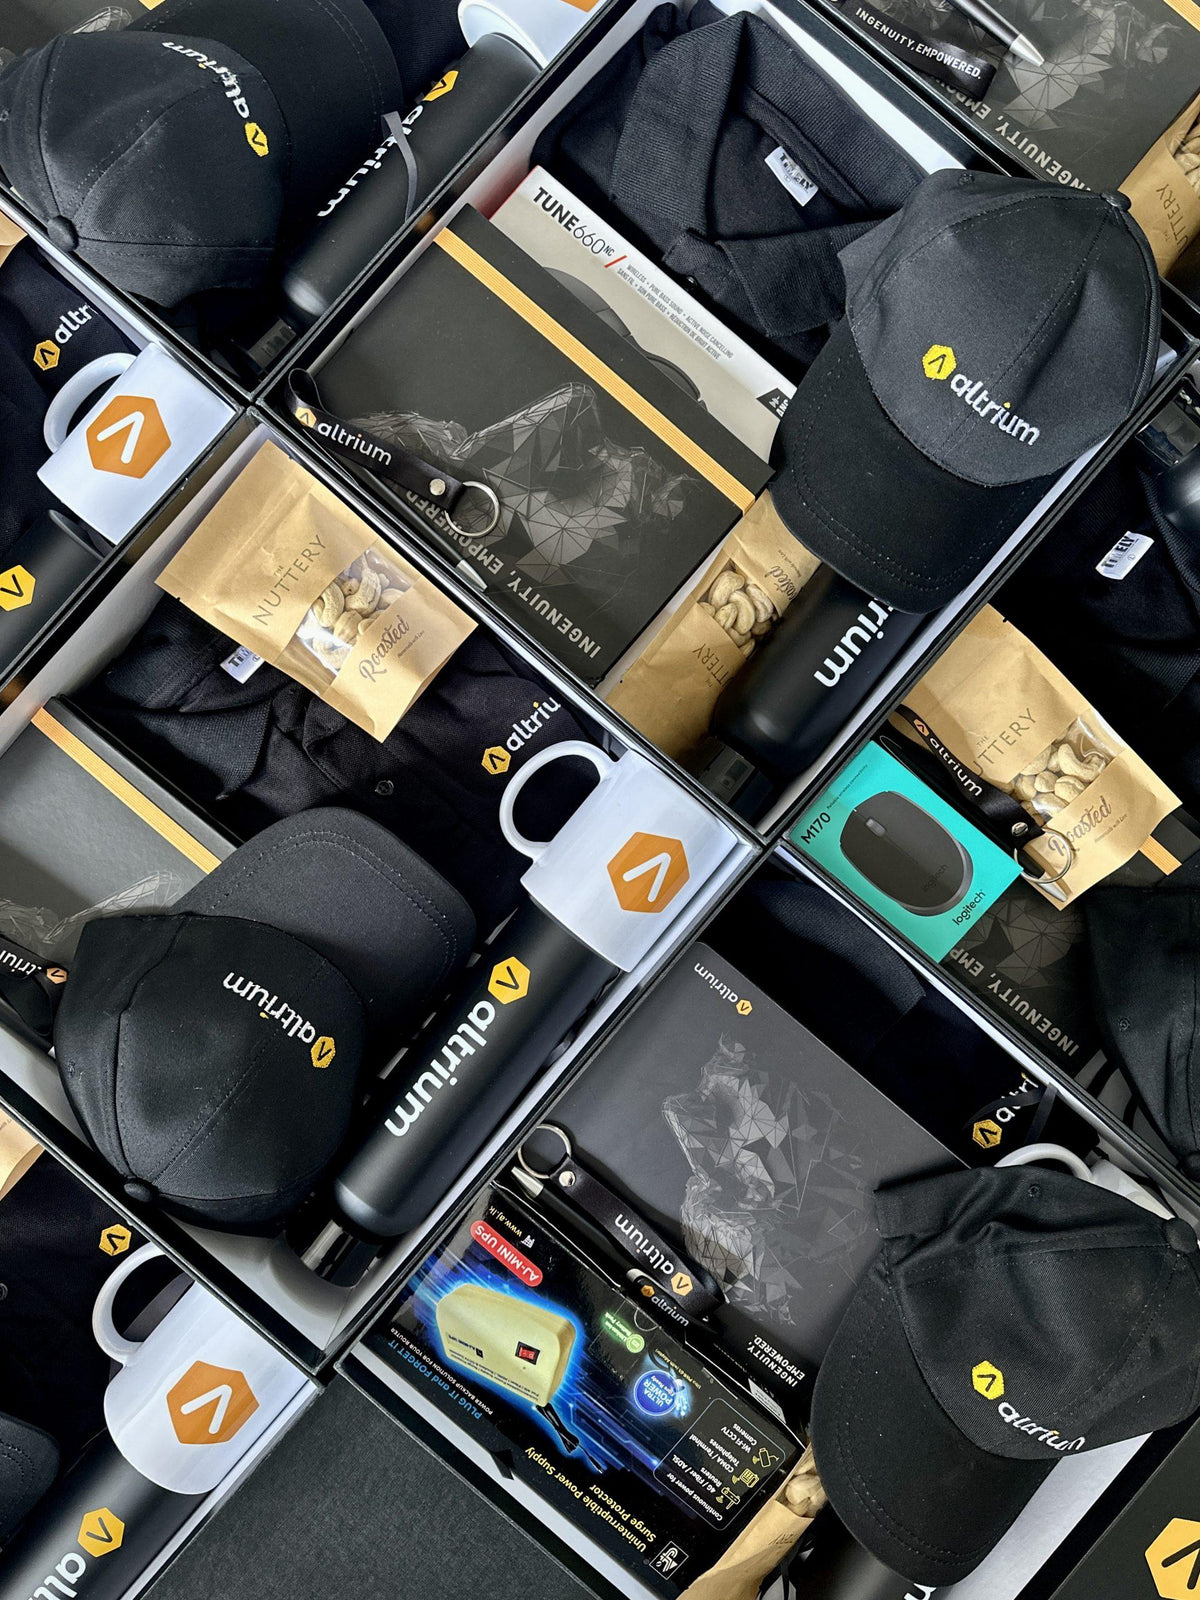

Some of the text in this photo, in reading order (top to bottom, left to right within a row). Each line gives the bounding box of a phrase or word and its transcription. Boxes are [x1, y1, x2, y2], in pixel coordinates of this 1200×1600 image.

[1156, 184, 1189, 247] UTTERY
[617, 268, 630, 281] SANS
[645, 291, 657, 305] PURE
[655, 300, 668, 313] BASS
[703, 343, 720, 360] ACTIVE
[627, 264, 647, 283] WIRELESS
[649, 284, 661, 297] PURE
[686, 314, 701, 331] ACTIVE
[55, 304, 96, 344] altr
[950, 374, 1040, 446] altrium
[317, 421, 392, 466] altrium
[252, 534, 327, 626] NUTTERY
[359, 614, 410, 683] Roasted
[813, 597, 893, 687] rium
[506, 697, 561, 751] altriu
[973, 708, 1036, 777] UTTERY
[930, 738, 983, 796] altrium
[801, 812, 831, 844] M170
[952, 890, 986, 925] logitech
[694, 963, 738, 1002] altrium
[950, 948, 984, 977] EMP
[222, 971, 316, 1044] altrium
[384, 1000, 496, 1137] altrium
[475, 1225, 540, 1282] AJ-MINI UPS
[614, 1213, 674, 1275] altrium
[651, 1295, 690, 1327] altrium
[388, 1340, 482, 1420] PLUG IT and FORGET IT
[390, 1327, 493, 1415] POWER BACKUP SOLUTION FOR YOUR ROUTER
[747, 1341, 798, 1388] INGENUITY,
[754, 1334, 806, 1380] EMPOWERED.
[643, 1379, 673, 1406] POWER
[643, 1390, 664, 1407] ULTRA
[689, 1434, 714, 1457] Terminal
[709, 1438, 740, 1467] Telephones
[721, 1426, 751, 1453] Wi-Fi CCTV
[732, 1423, 758, 1446] Cameras
[671, 1454, 688, 1470] ADSL
[690, 1469, 704, 1482] Fiber
[700, 1467, 722, 1488] Routers
[717, 1457, 734, 1473] CDMA
[525, 1446, 647, 1553] Uninterruptible Power Supply
[667, 1472, 723, 1521] Continuous power for
[706, 1484, 716, 1494] 4G
[589, 1485, 657, 1543] Surge Protector
